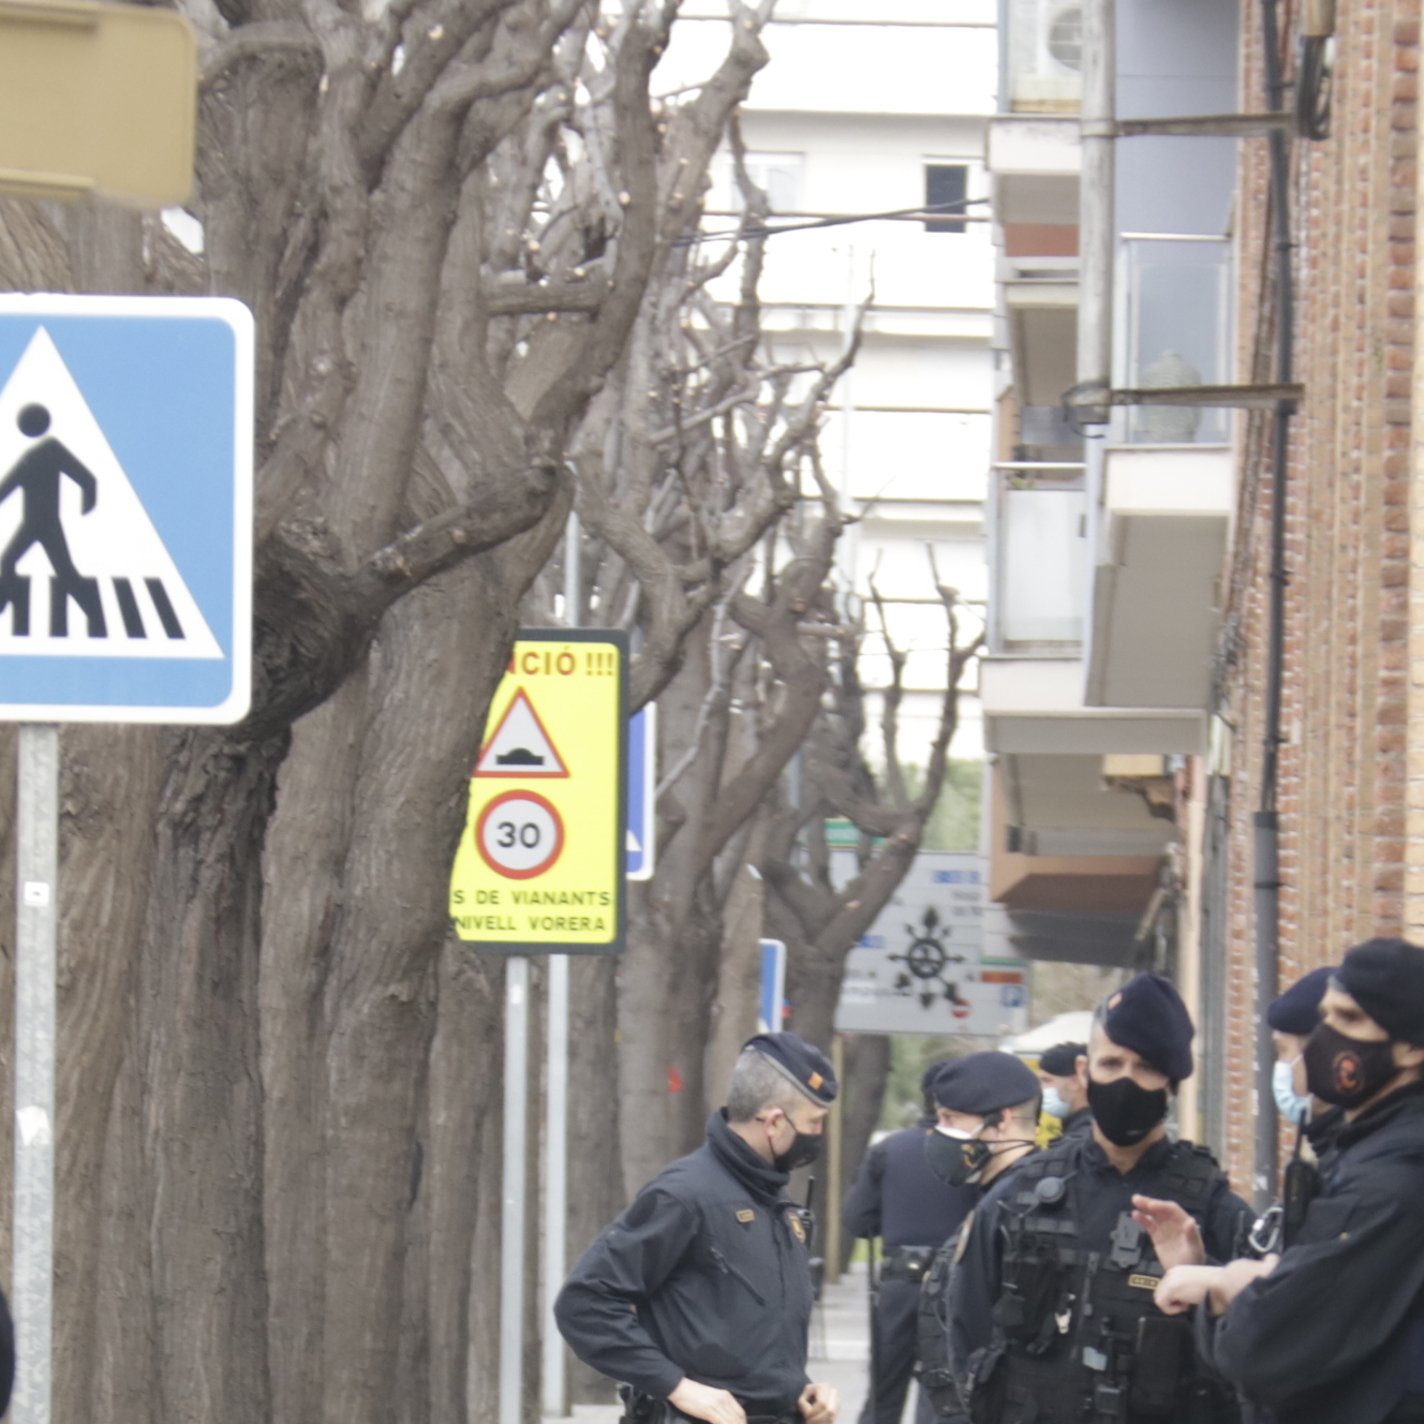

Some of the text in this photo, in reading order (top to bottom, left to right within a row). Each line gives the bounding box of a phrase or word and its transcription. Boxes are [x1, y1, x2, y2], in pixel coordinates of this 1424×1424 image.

[496, 822, 540, 849] 30
[453, 890, 611, 906] S DE VIANANTS
[455, 915, 606, 931] NIVELL VORERA
